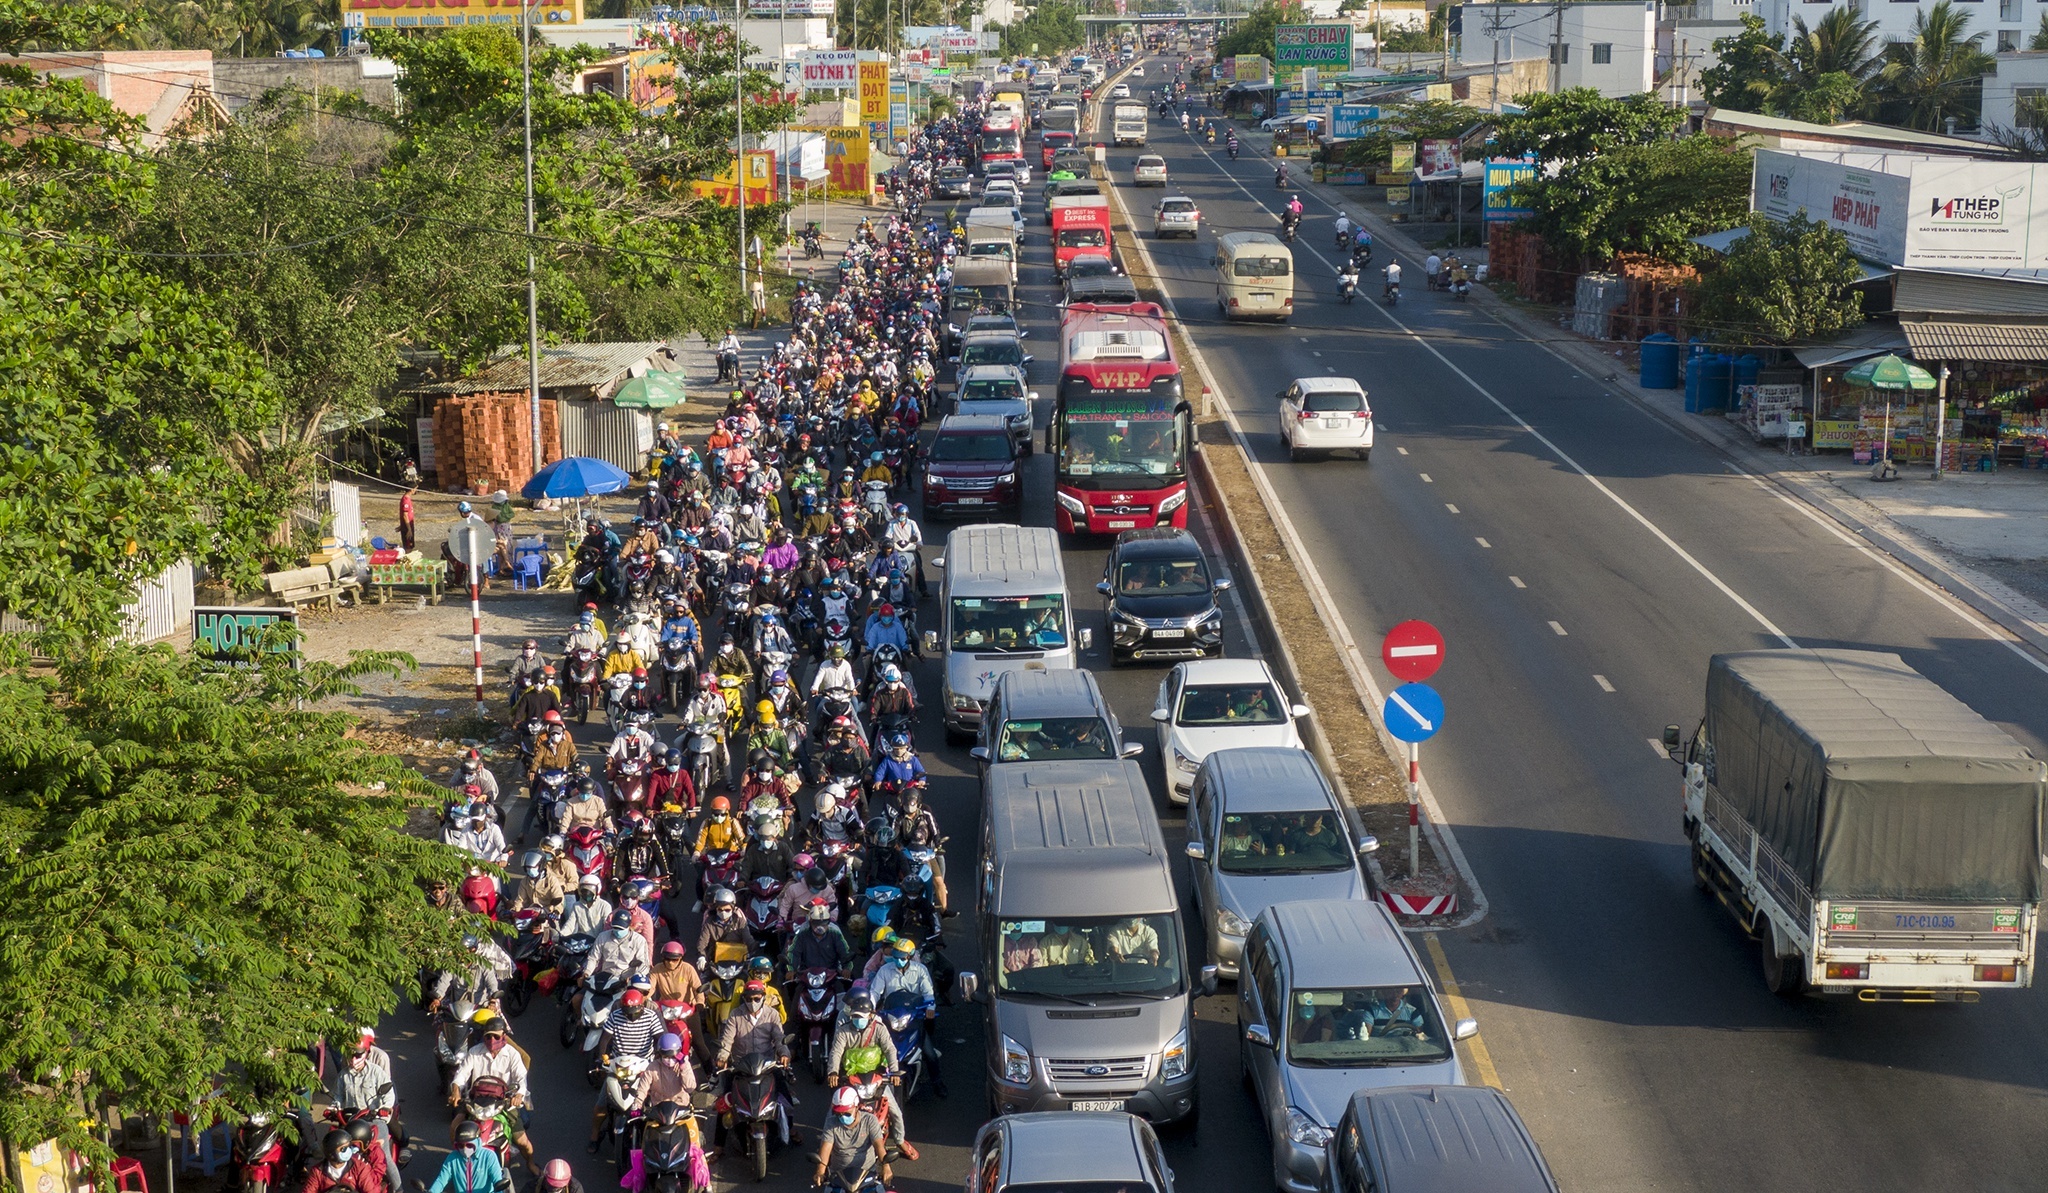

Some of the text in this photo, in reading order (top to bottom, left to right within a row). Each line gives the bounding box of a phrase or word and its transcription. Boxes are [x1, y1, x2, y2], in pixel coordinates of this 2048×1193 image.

[1308, 26, 1347, 44] CHAY
[1278, 48, 1302, 60] LAN
[1340, 47, 1348, 60] 3
[860, 62, 887, 79] PHÁT
[862, 82, 886, 99] ĐẠT
[867, 100, 881, 113] BT
[829, 129, 862, 140] CHỌN
[1489, 169, 1511, 186] MUA
[1953, 195, 2000, 211] THÉP
[1832, 193, 1881, 230] HIỆP PHÁT
[1953, 211, 1999, 219] TUNG HO
[198, 613, 289, 653] HOTEL
[1834, 912, 1856, 920] CRB
[1089, 1066, 1106, 1075] Ford
